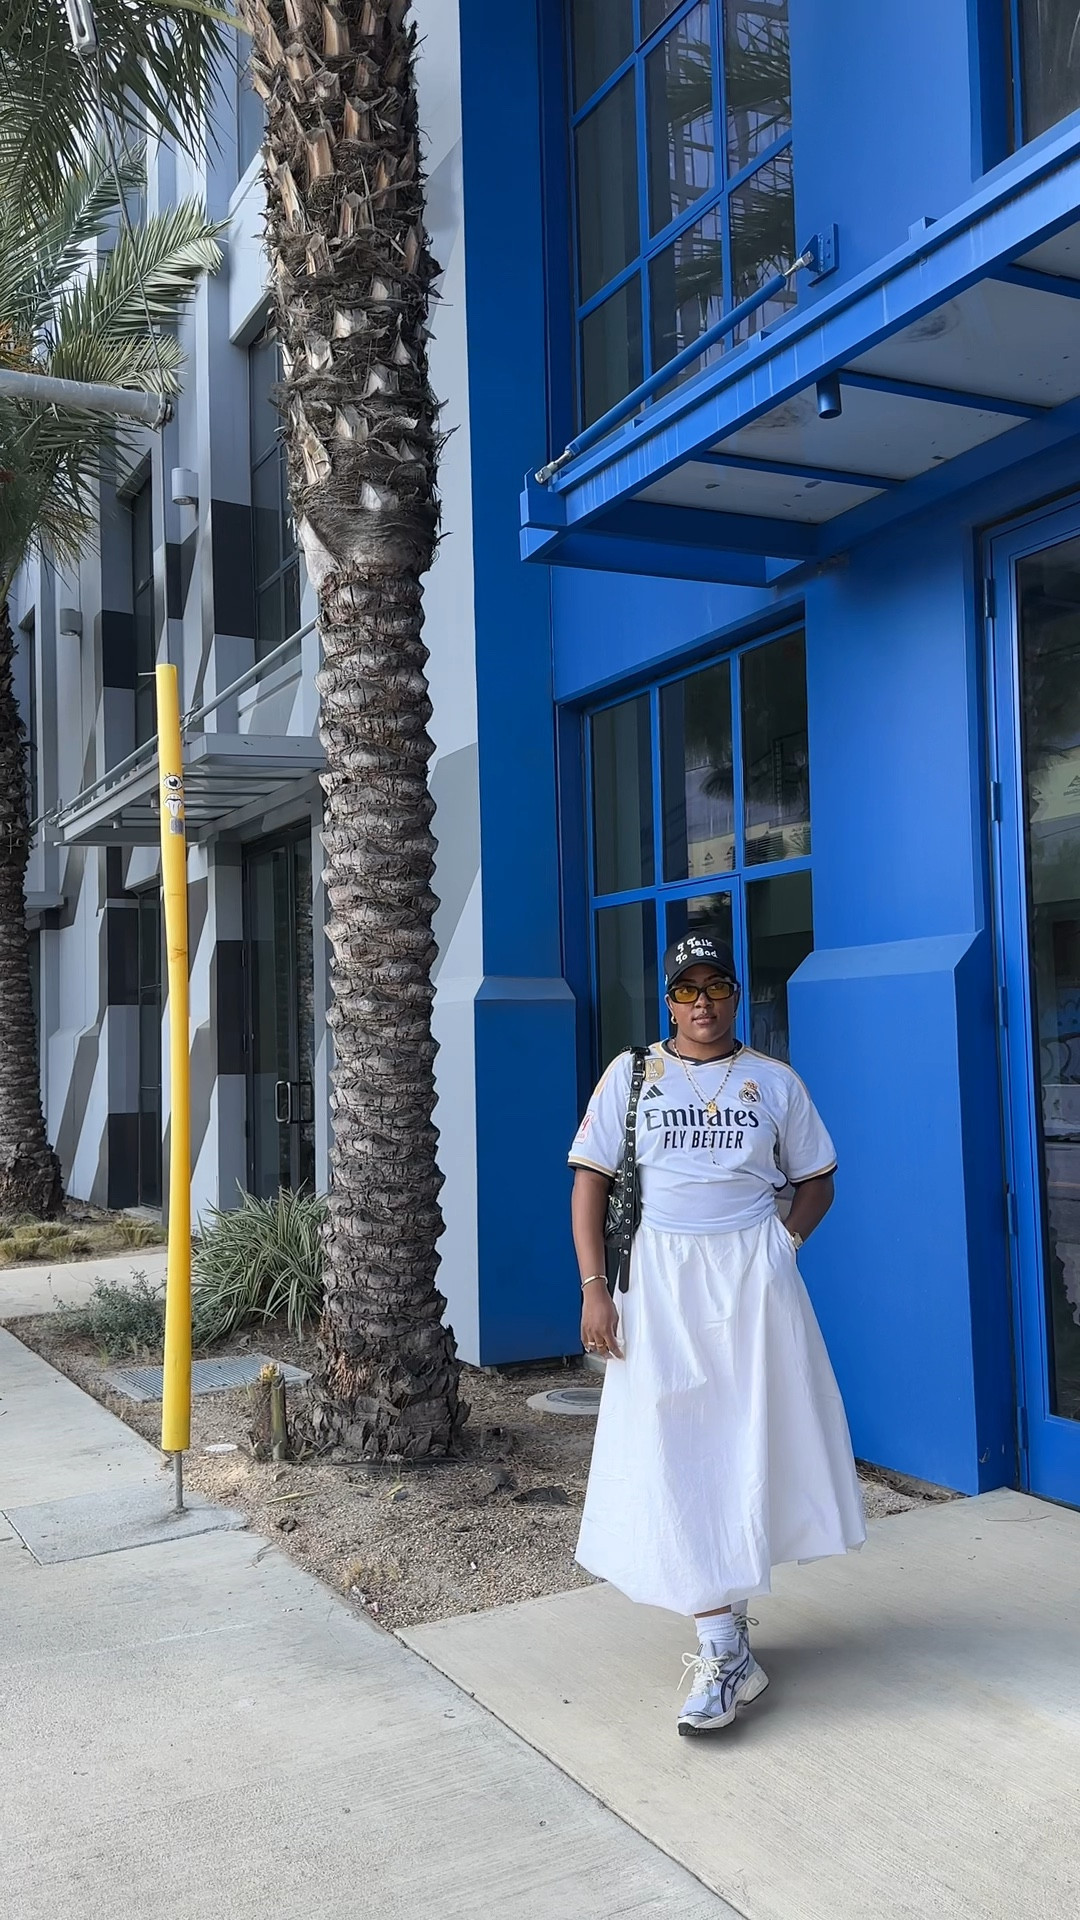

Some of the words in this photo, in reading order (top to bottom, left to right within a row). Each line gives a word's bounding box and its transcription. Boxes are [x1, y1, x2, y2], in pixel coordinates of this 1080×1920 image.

[687, 937, 713, 948] Talk
[676, 952, 688, 964] To
[691, 947, 718, 958] God
[643, 1104, 760, 1132] Emirates
[664, 1130, 687, 1149] FLY
[691, 1130, 744, 1149] BETTER
